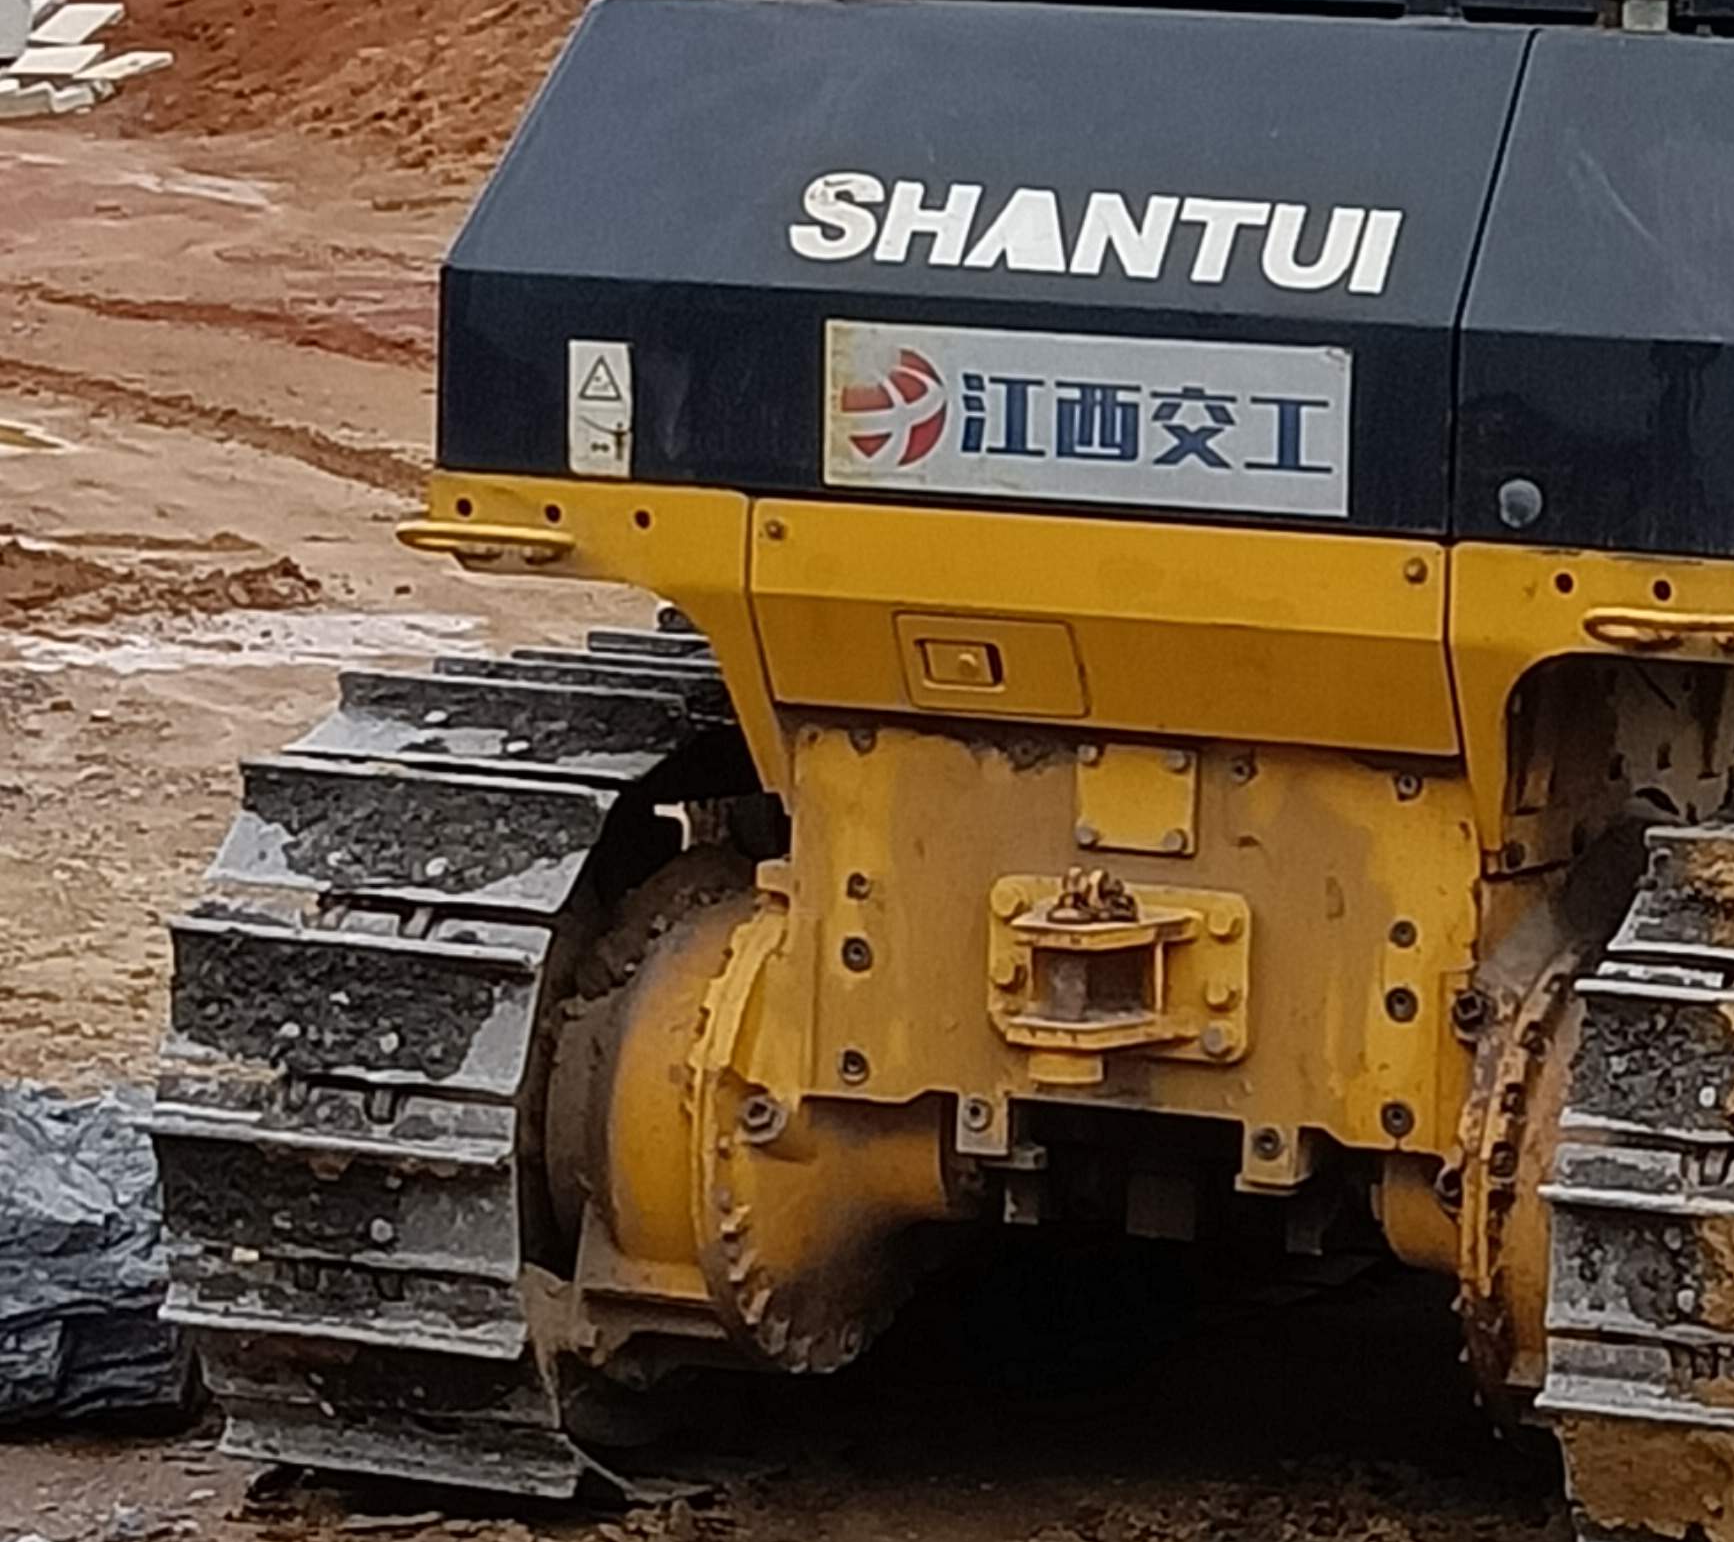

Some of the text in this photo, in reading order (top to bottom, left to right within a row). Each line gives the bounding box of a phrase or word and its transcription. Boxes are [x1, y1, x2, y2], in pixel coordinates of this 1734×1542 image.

[789, 172, 1402, 294] SHANTUI
[960, 373, 1333, 474] 江西交工
